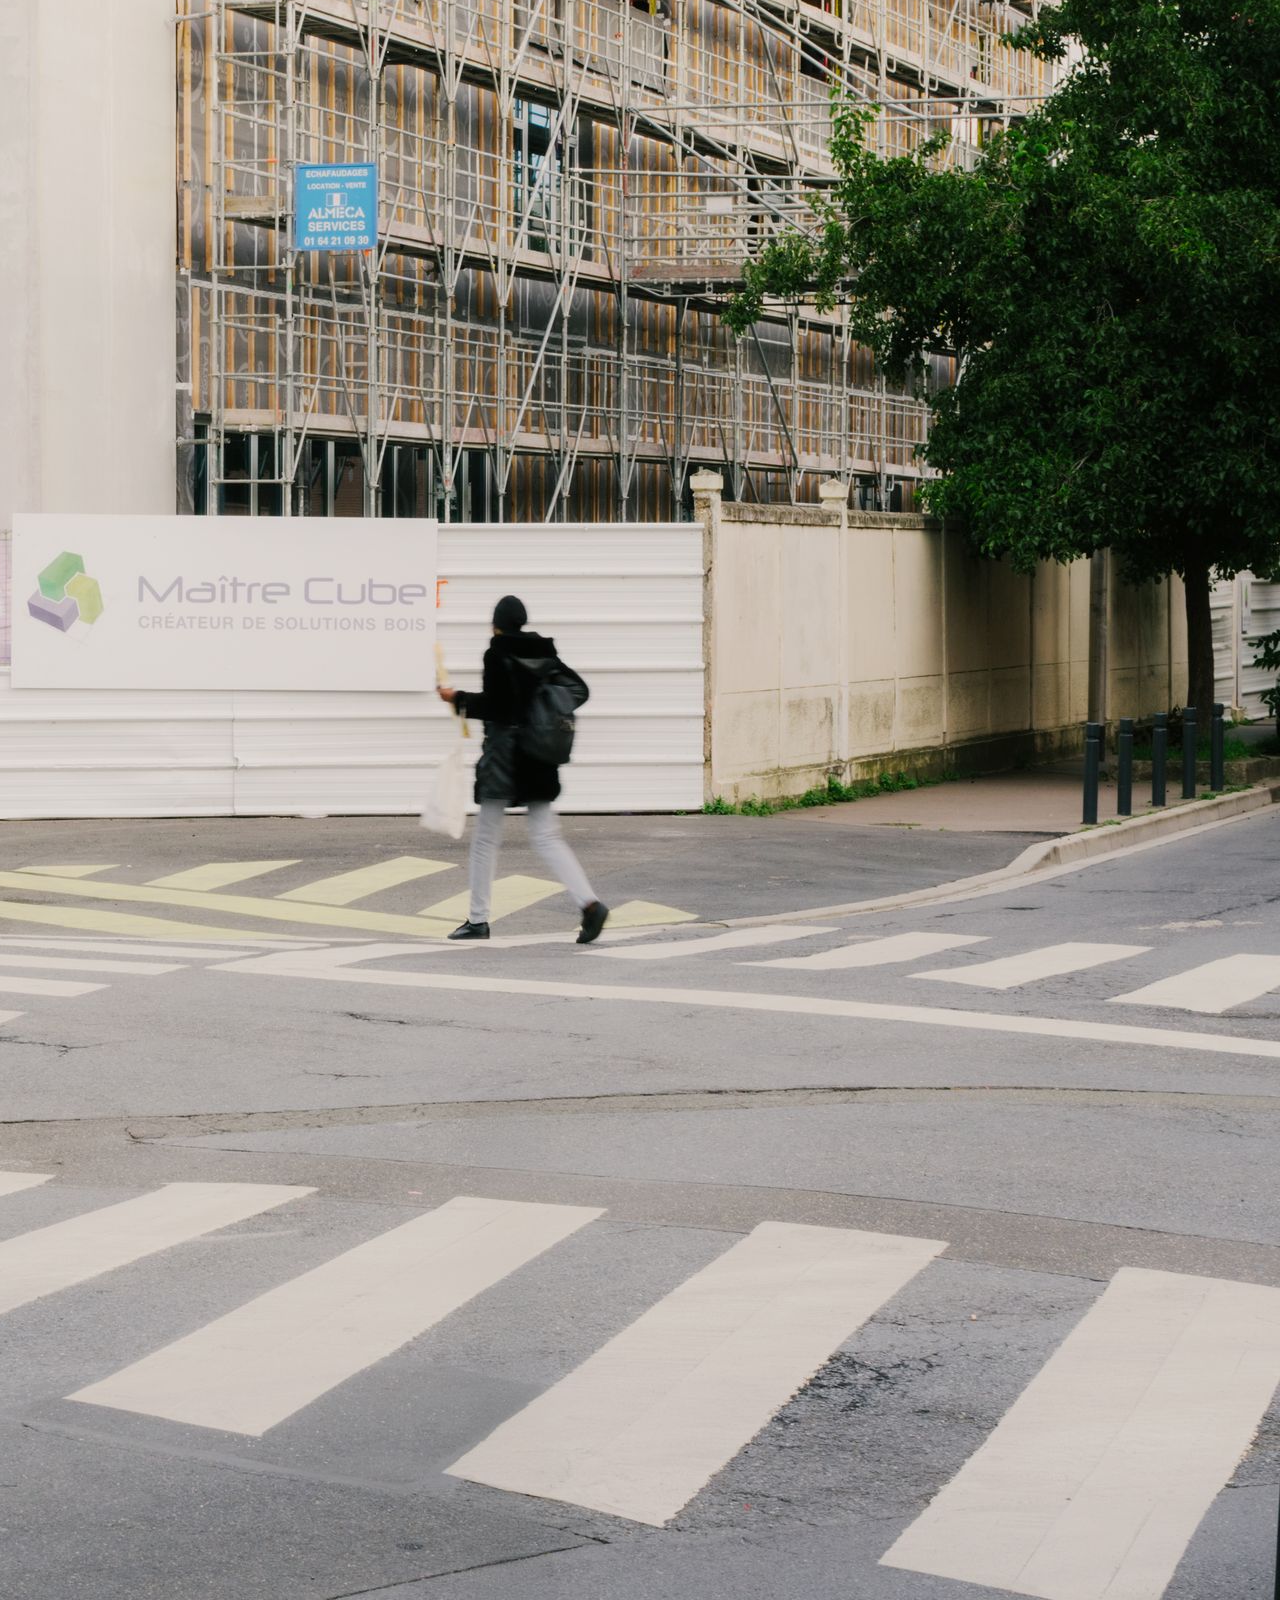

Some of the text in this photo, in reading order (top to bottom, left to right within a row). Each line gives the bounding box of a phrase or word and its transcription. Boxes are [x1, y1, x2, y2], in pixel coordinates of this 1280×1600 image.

[306, 168, 368, 178] ECHAFAUDAGES
[307, 182, 340, 190] LOCATION
[345, 181, 367, 189] VENTE
[308, 206, 365, 220] ALMECA
[308, 220, 365, 232] SERVICES
[304, 237, 315, 247] 01
[330, 236, 341, 245] 21
[138, 575, 427, 606] Maître Cube
[138, 612, 427, 632] CRÉATEUR DE SOLUTIONS BOIS
